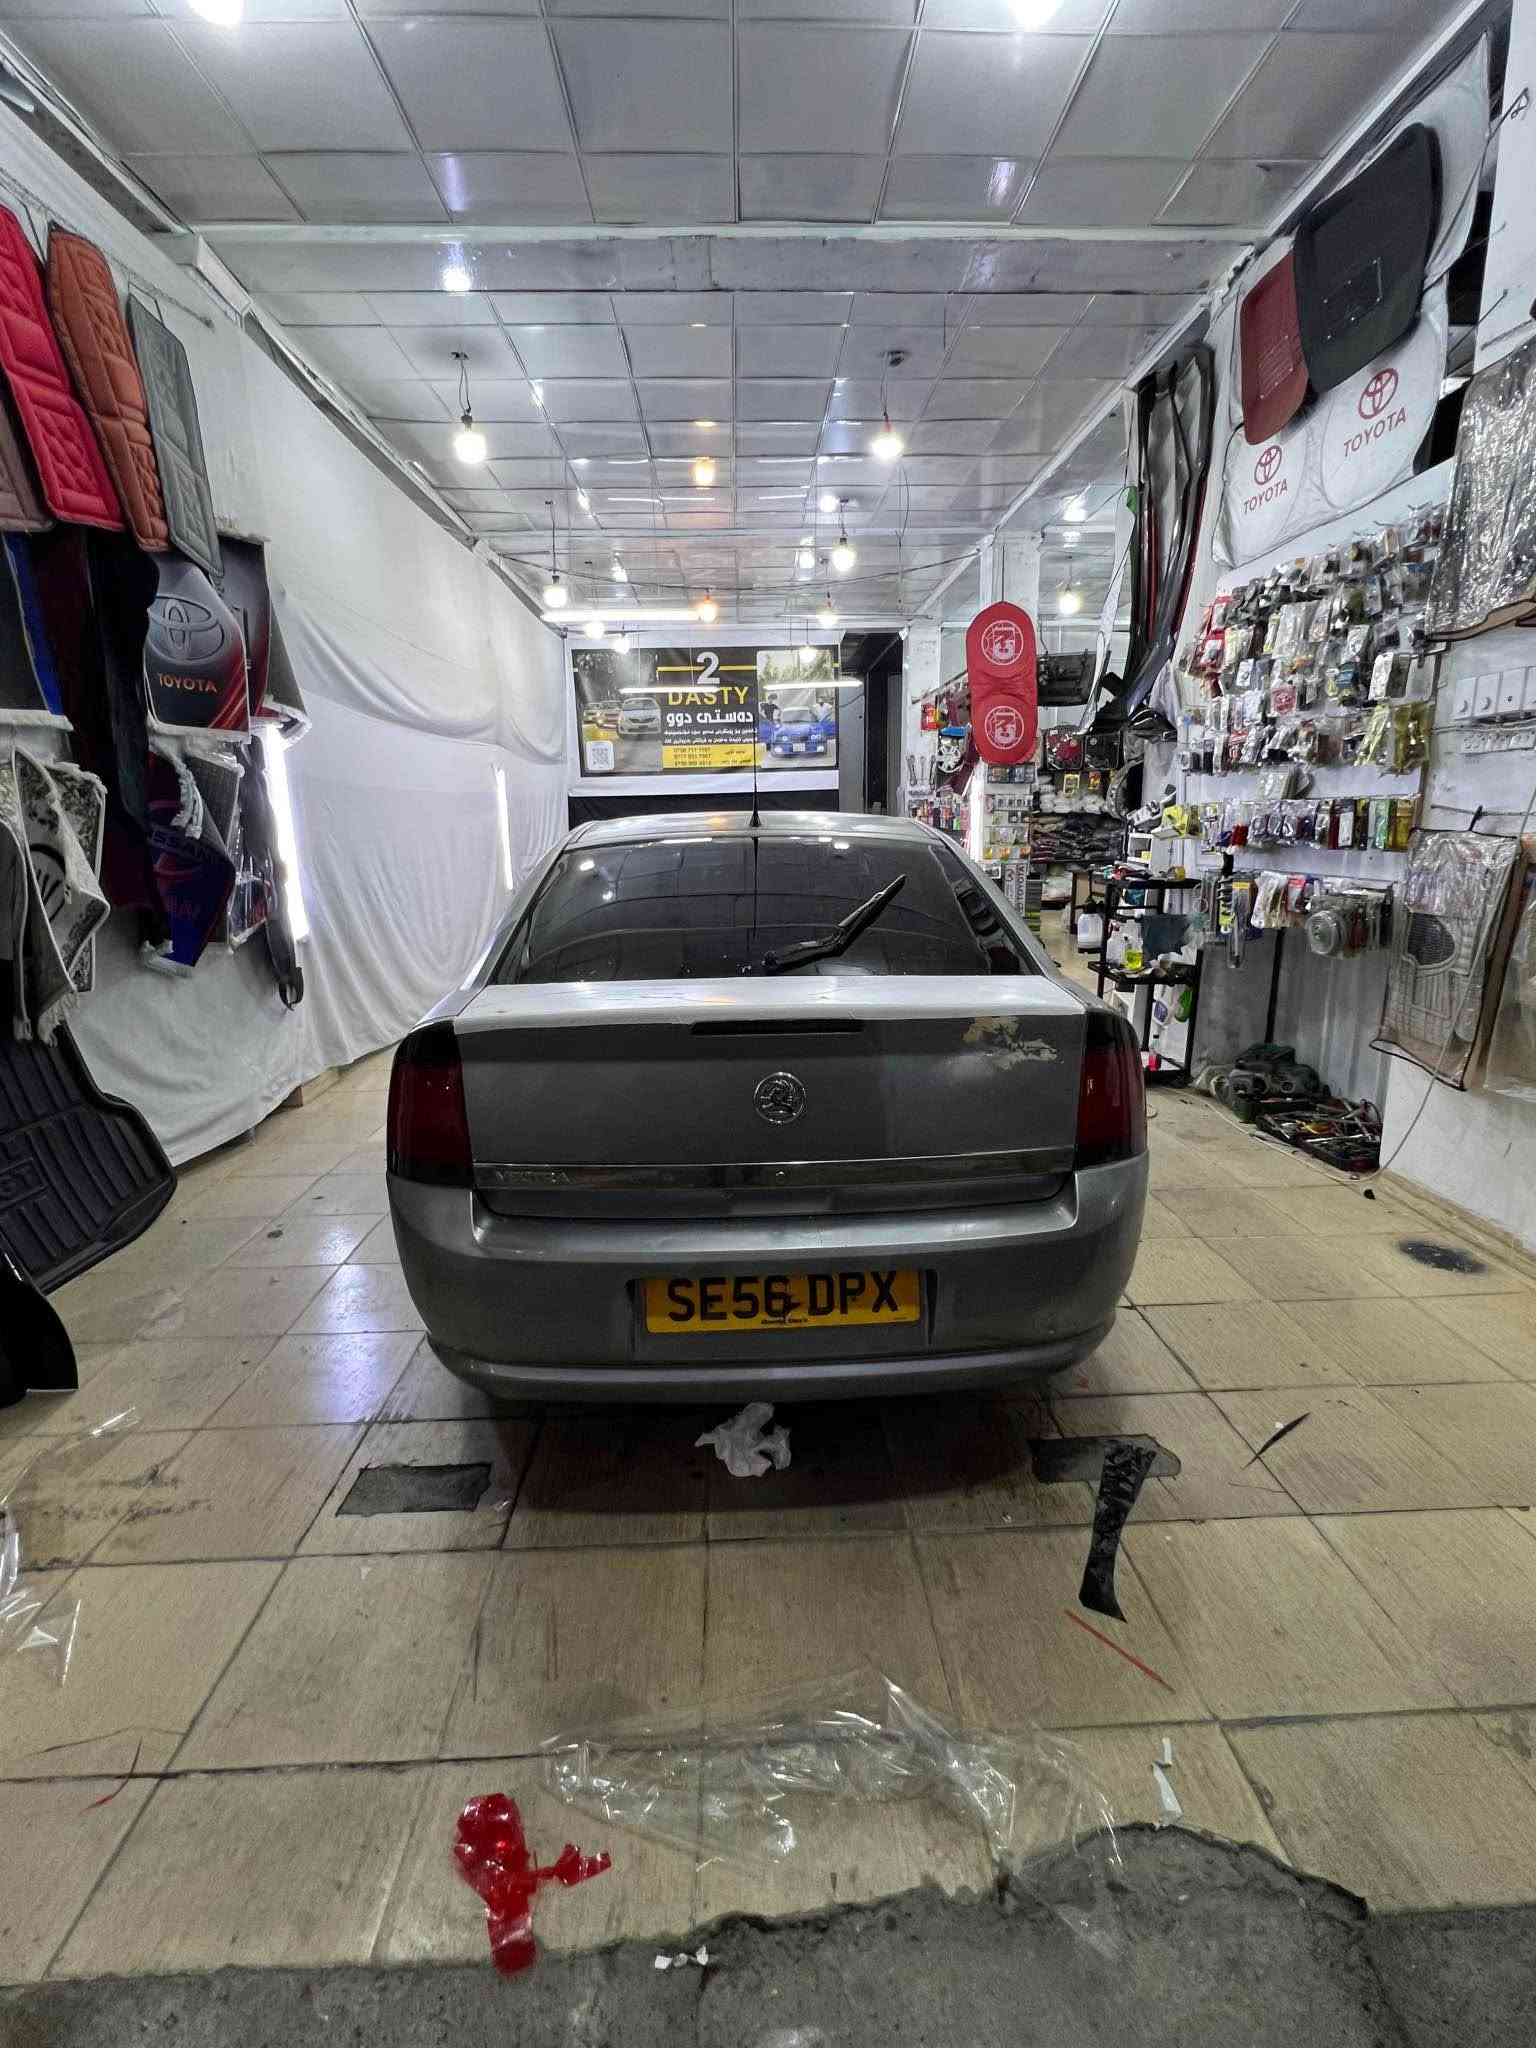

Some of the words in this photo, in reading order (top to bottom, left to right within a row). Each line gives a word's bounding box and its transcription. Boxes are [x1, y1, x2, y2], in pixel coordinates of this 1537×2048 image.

[1343, 407, 1408, 458] TOYOTA
[1243, 478, 1288, 515] TOYOTA
[156, 672, 218, 694] TOYOTA
[696, 651, 721, 685] 2
[668, 686, 749, 706] DASTY
[667, 1275, 793, 1322] SE56
[806, 1270, 900, 1317] DPX
